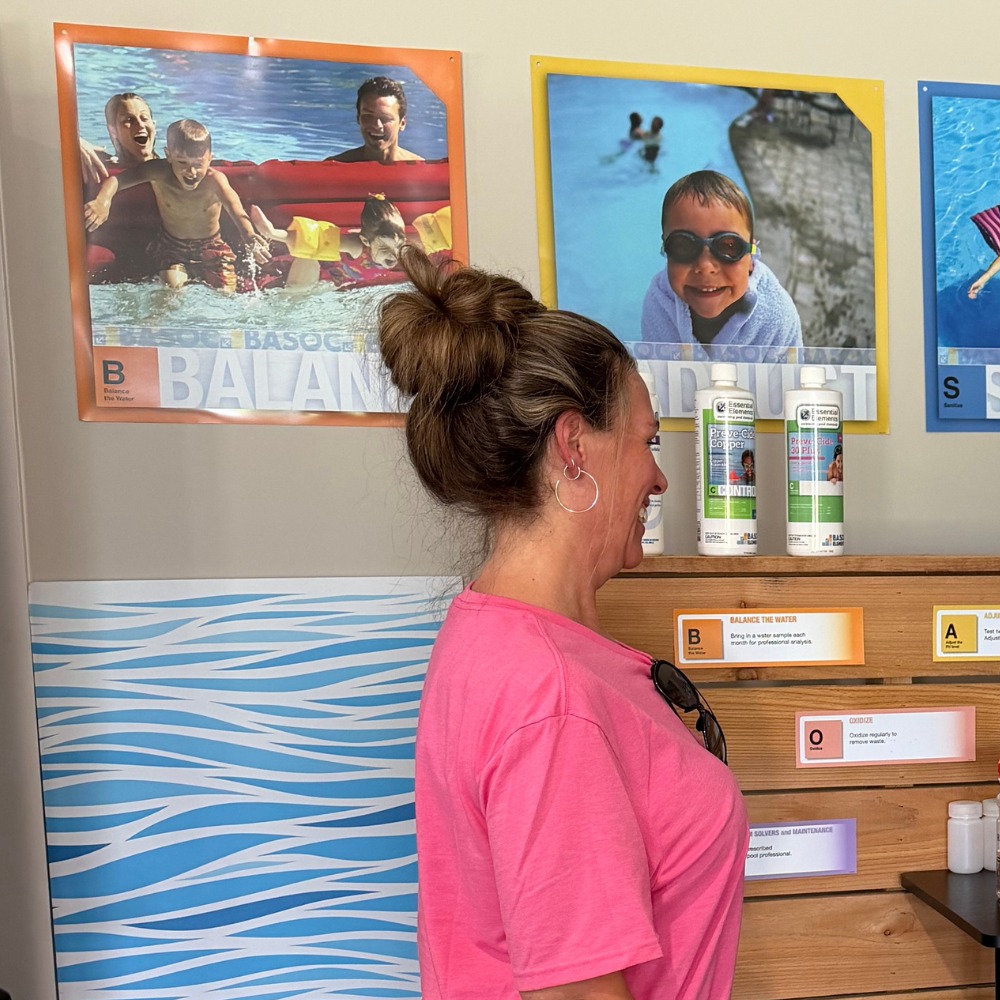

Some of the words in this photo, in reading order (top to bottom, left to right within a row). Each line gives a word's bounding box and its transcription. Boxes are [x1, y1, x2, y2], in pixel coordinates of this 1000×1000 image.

[102, 359, 125, 385] B
[159, 348, 397, 412] BALAN
[943, 376, 960, 400] S
[710, 439, 744, 450] Copper
[710, 486, 716, 494] C
[789, 482, 795, 490] C
[687, 628, 701, 645] B
[945, 623, 958, 639] A
[849, 716, 873, 724] OXIDIZE
[809, 729, 824, 746] O
[754, 829, 779, 837] SOLVERS
[793, 826, 833, 835] MAINTENANCE
